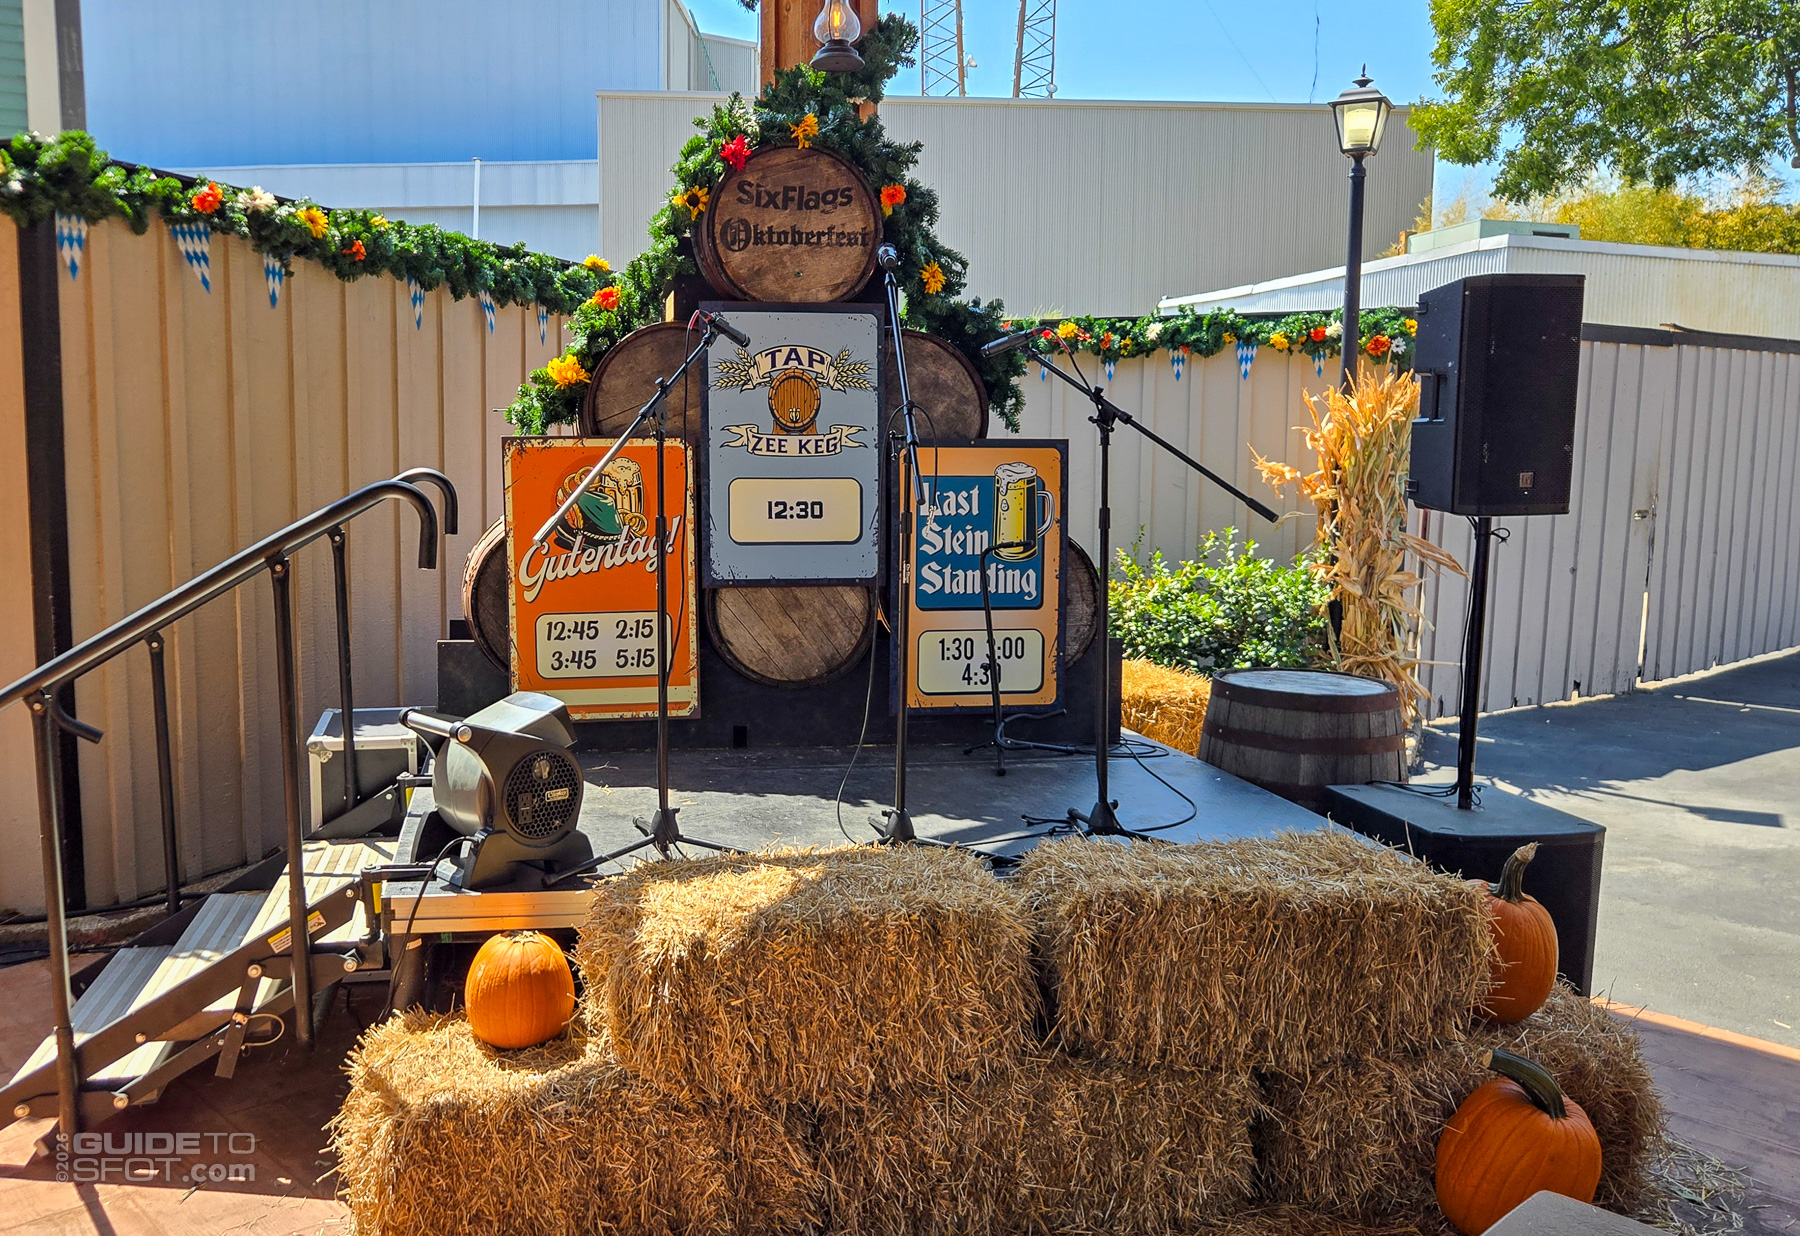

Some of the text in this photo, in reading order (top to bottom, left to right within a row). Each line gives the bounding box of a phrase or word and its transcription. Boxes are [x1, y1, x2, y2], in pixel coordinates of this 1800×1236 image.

[720, 217, 870, 252] Oktoberfest
[764, 348, 825, 369] TAP
[751, 434, 838, 455] ZEE KEG
[767, 500, 824, 520] 12:30
[919, 482, 980, 516] Last
[919, 522, 989, 555] Stein
[919, 561, 1038, 601] Standing
[546, 618, 654, 641] 12:45 2:15
[551, 648, 656, 671] 3:45 5:15
[939, 637, 974, 661] 1:30
